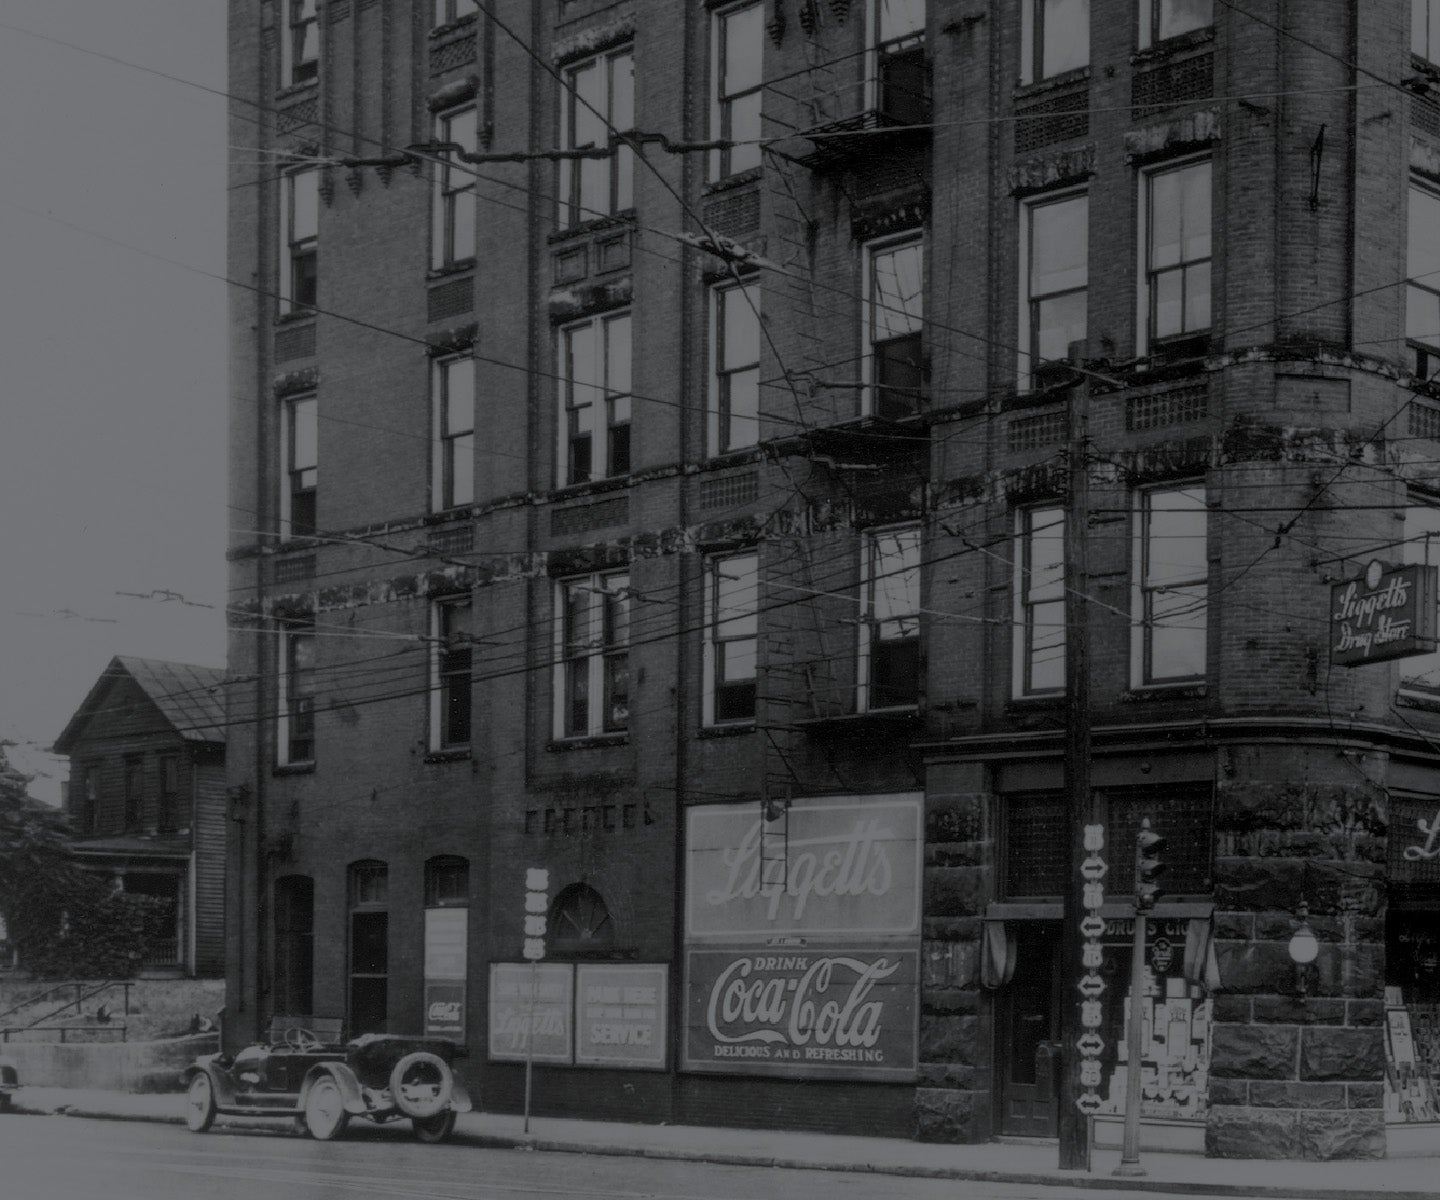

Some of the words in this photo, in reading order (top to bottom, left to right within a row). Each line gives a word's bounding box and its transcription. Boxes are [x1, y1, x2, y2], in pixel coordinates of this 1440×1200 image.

[1333, 621, 1373, 657] Drug
[1372, 614, 1412, 645] Store
[1106, 918, 1157, 936] DRUS
[753, 956, 808, 971] DRINK
[707, 955, 904, 1048] Coca-Cola
[589, 1022, 652, 1045] SERVICE
[714, 1044, 771, 1058] DELICIOUS
[774, 1048, 801, 1059] AND
[805, 1048, 884, 1062] REFRESHING
